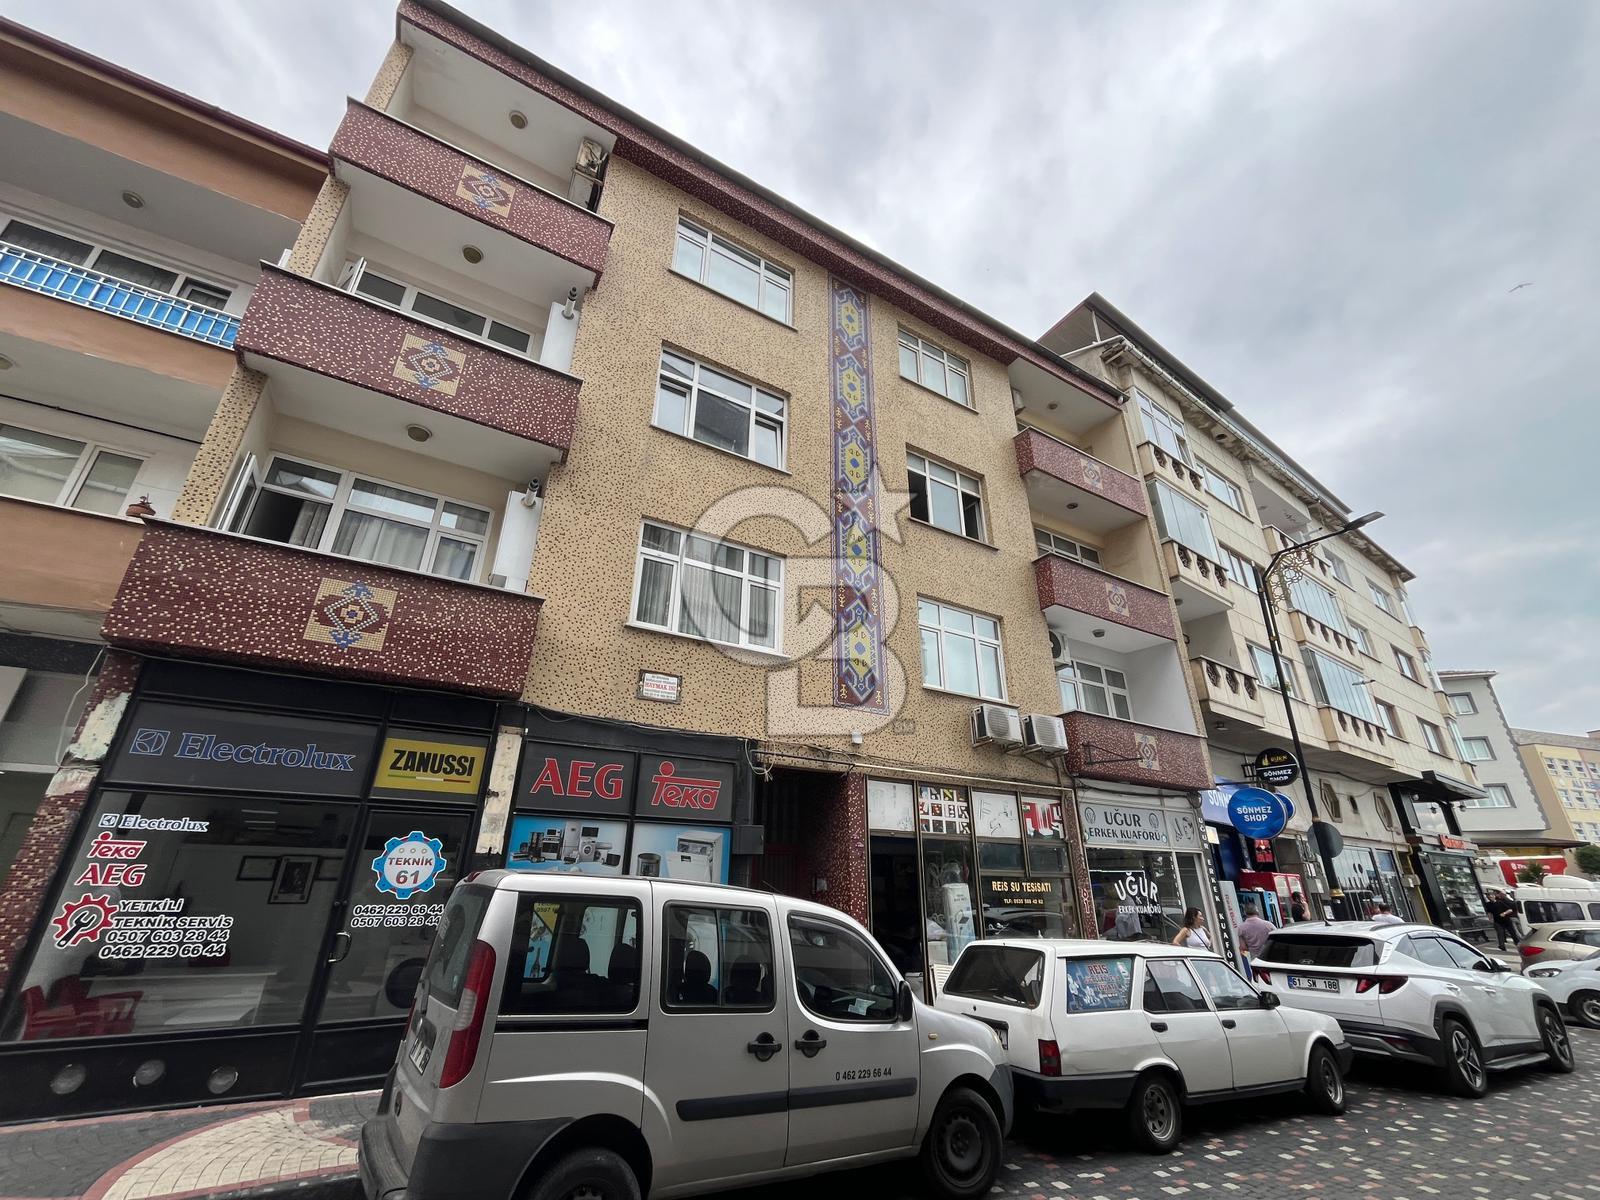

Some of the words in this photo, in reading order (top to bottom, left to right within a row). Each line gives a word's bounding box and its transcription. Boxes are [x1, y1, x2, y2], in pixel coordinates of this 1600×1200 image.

[174, 732, 357, 772] Electrolux
[389, 749, 475, 776] ZANUSSI
[530, 757, 624, 800] AEG
[1263, 768, 1293, 777] SÖNMEZ
[1237, 805, 1273, 815] SÖNMEZ
[118, 814, 210, 832] Electrolux
[1104, 809, 1142, 827] UĞUR
[1243, 814, 1268, 822] SHOP
[1088, 827, 1119, 839] ERKEK
[388, 856, 433, 866] TEKNİK
[74, 863, 148, 887] AEG
[395, 870, 420, 885] 61
[1206, 859, 1221, 902] ERKEK
[1010, 881, 1020, 892] SU
[1114, 871, 1158, 903] UĞUR
[120, 898, 184, 912] YETKİLİ
[353, 904, 385, 915] 0462
[385, 904, 410, 915] 229
[411, 904, 427, 915] 66
[427, 903, 444, 914] 44
[112, 915, 177, 929] TEKNİK
[176, 915, 233, 929] SERVİS
[351, 917, 382, 927] 0507
[383, 916, 407, 927] 603
[408, 916, 424, 926] 28
[425, 915, 441, 925] 44
[106, 930, 150, 942] 0507
[151, 930, 182, 942] 603
[184, 930, 206, 942] 28
[207, 930, 230, 942] 44
[99, 945, 145, 959] 0462
[144, 944, 179, 958] 229
[179, 944, 203, 957] 66
[202, 943, 227, 957] 44
[1292, 977, 1301, 986] 61
[835, 1071, 840, 1081] 0
[842, 1070, 856, 1080] 462
[858, 1069, 871, 1079] 229
[872, 1068, 882, 1078] 66
[883, 1067, 892, 1076] 44
